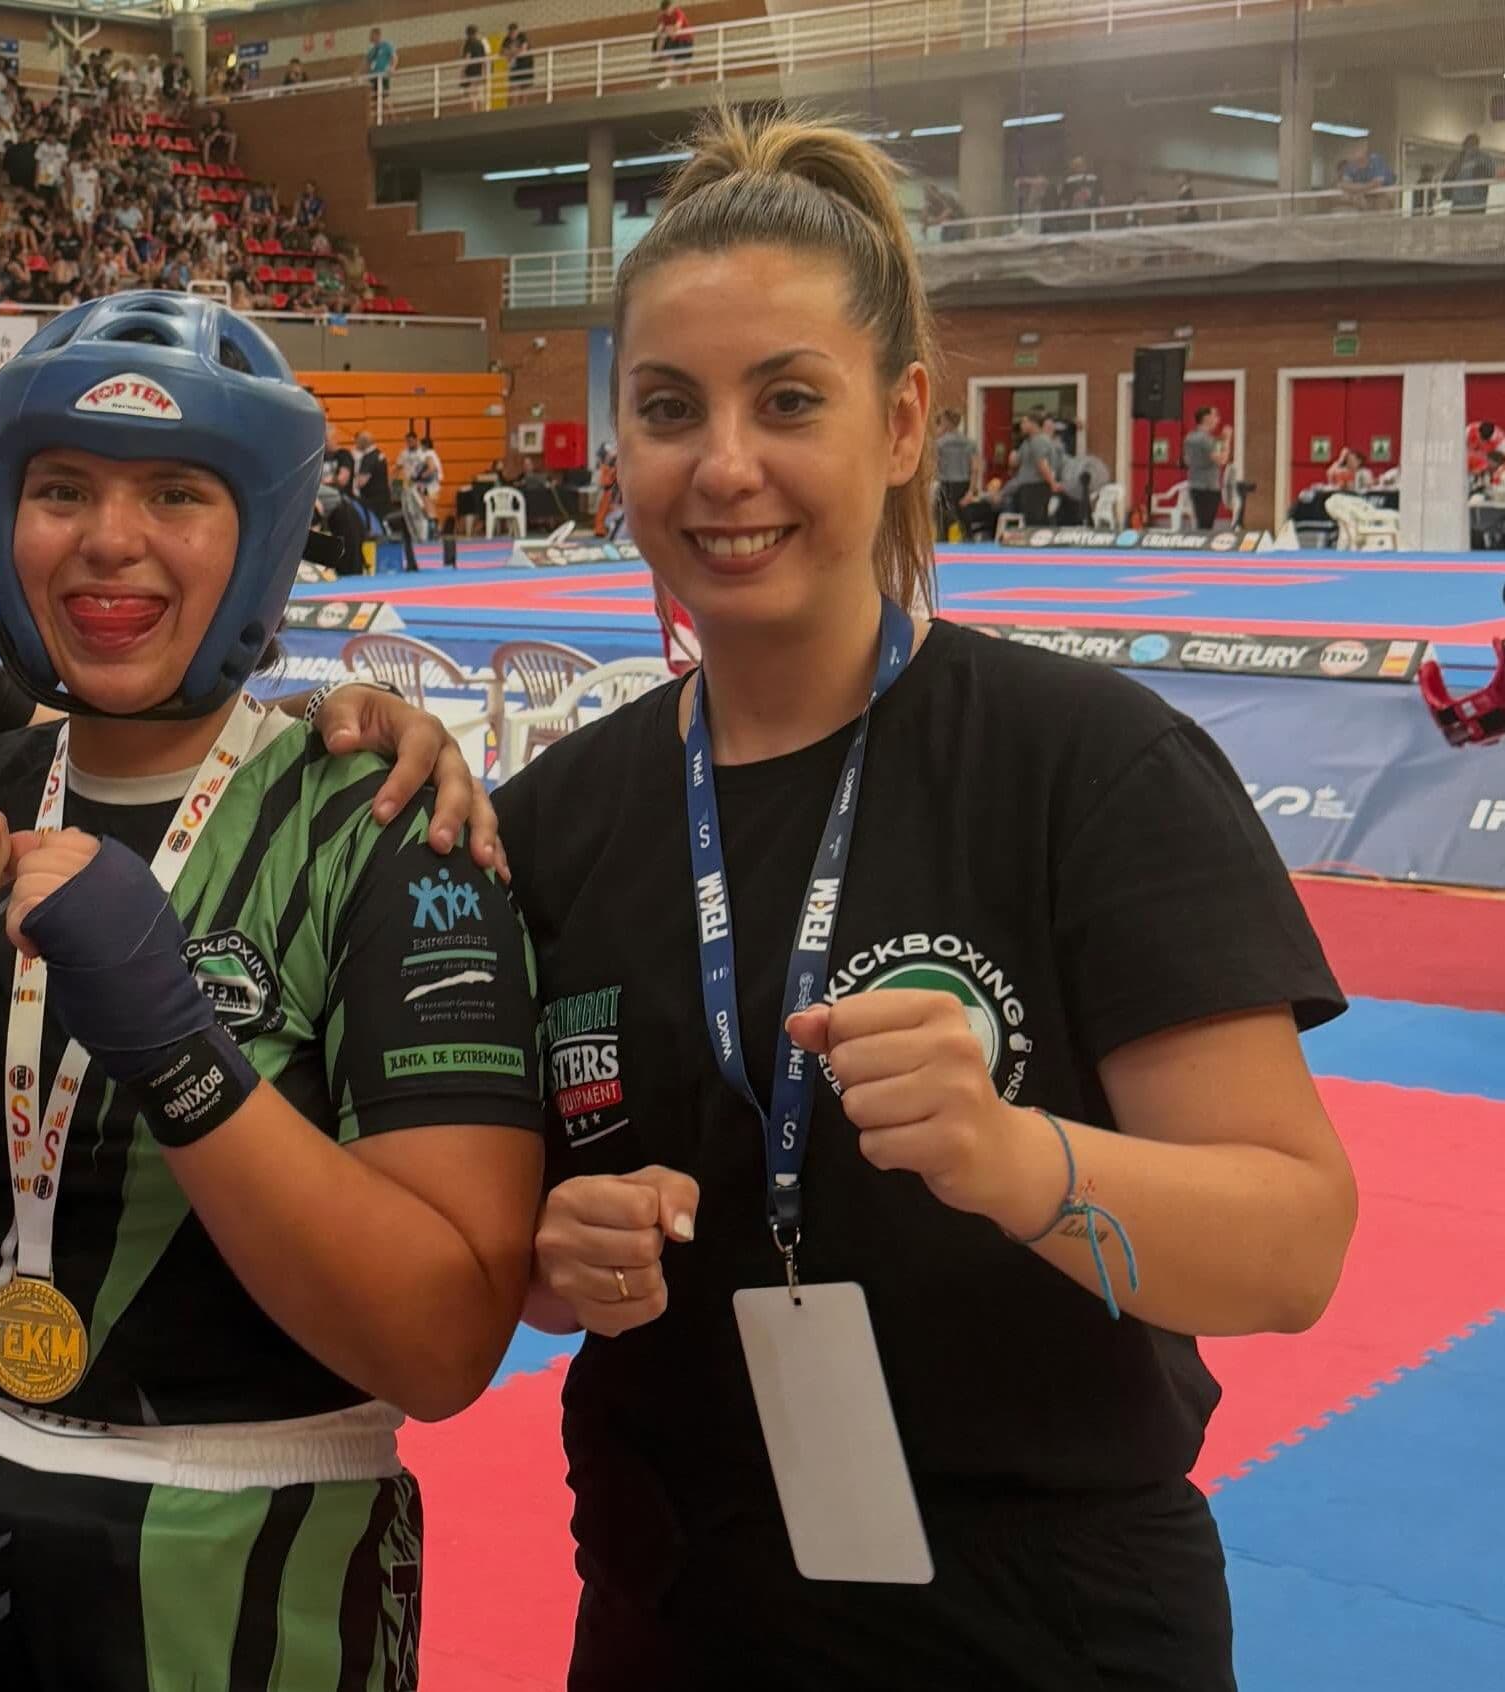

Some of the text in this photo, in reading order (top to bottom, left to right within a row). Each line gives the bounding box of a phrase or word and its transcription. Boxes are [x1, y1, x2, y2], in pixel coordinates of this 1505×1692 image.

[85, 382, 174, 412] TOP TEN
[1180, 640, 1308, 669] CENTURY
[697, 871, 729, 945] FEKM
[798, 877, 841, 952] FEKM
[823, 932, 1025, 1027] KICKBOXING
[389, 1050, 523, 1069] JUNTA DE EXTREMADURA
[163, 1063, 224, 1119] BOXING
